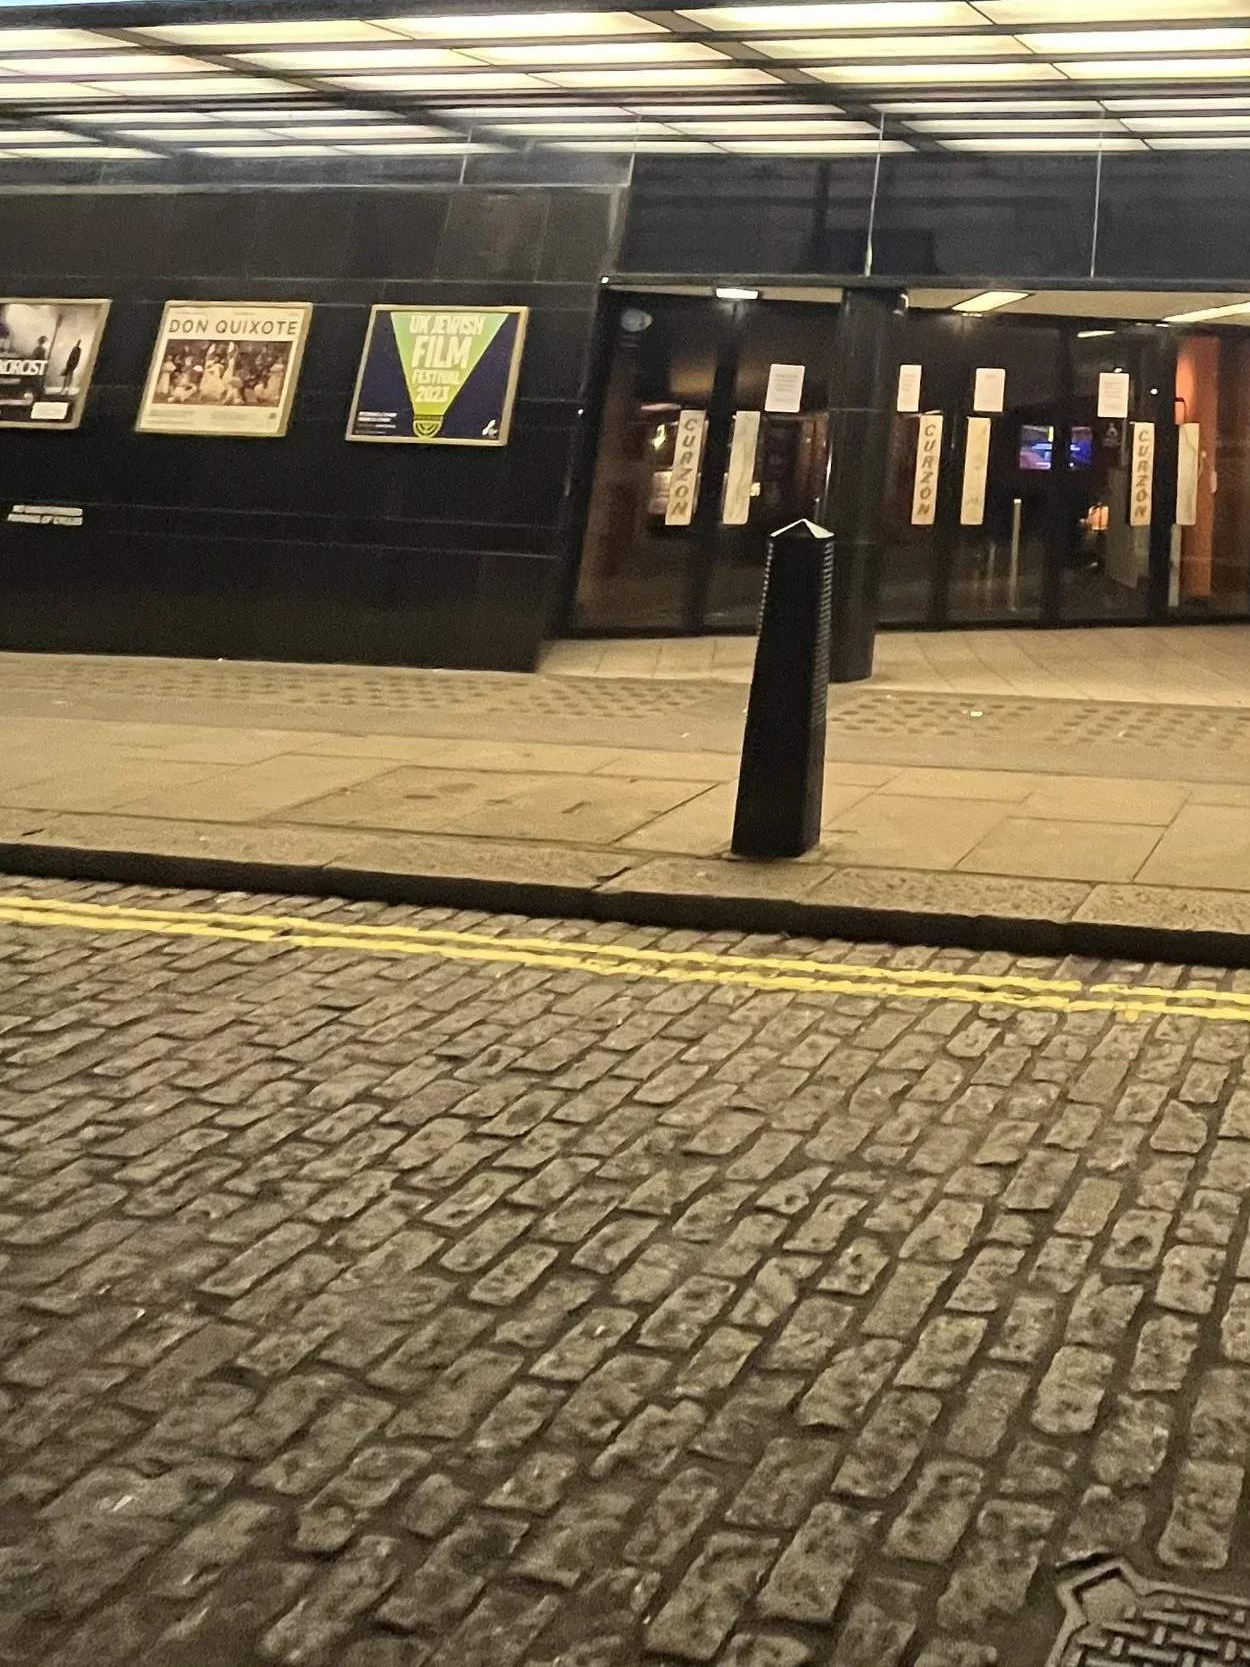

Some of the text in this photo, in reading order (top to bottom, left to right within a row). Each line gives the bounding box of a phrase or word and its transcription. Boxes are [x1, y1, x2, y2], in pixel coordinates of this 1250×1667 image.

[169, 319, 298, 335] DON QUIXOTE
[409, 314, 487, 335] UK JEWISH
[411, 335, 473, 370] FILM
[411, 368, 460, 385] FESTIVAL
[415, 385, 450, 403] 2023
[670, 417, 699, 516] CURZON
[916, 423, 938, 516] CURZON
[1133, 429, 1150, 517] CURZON
